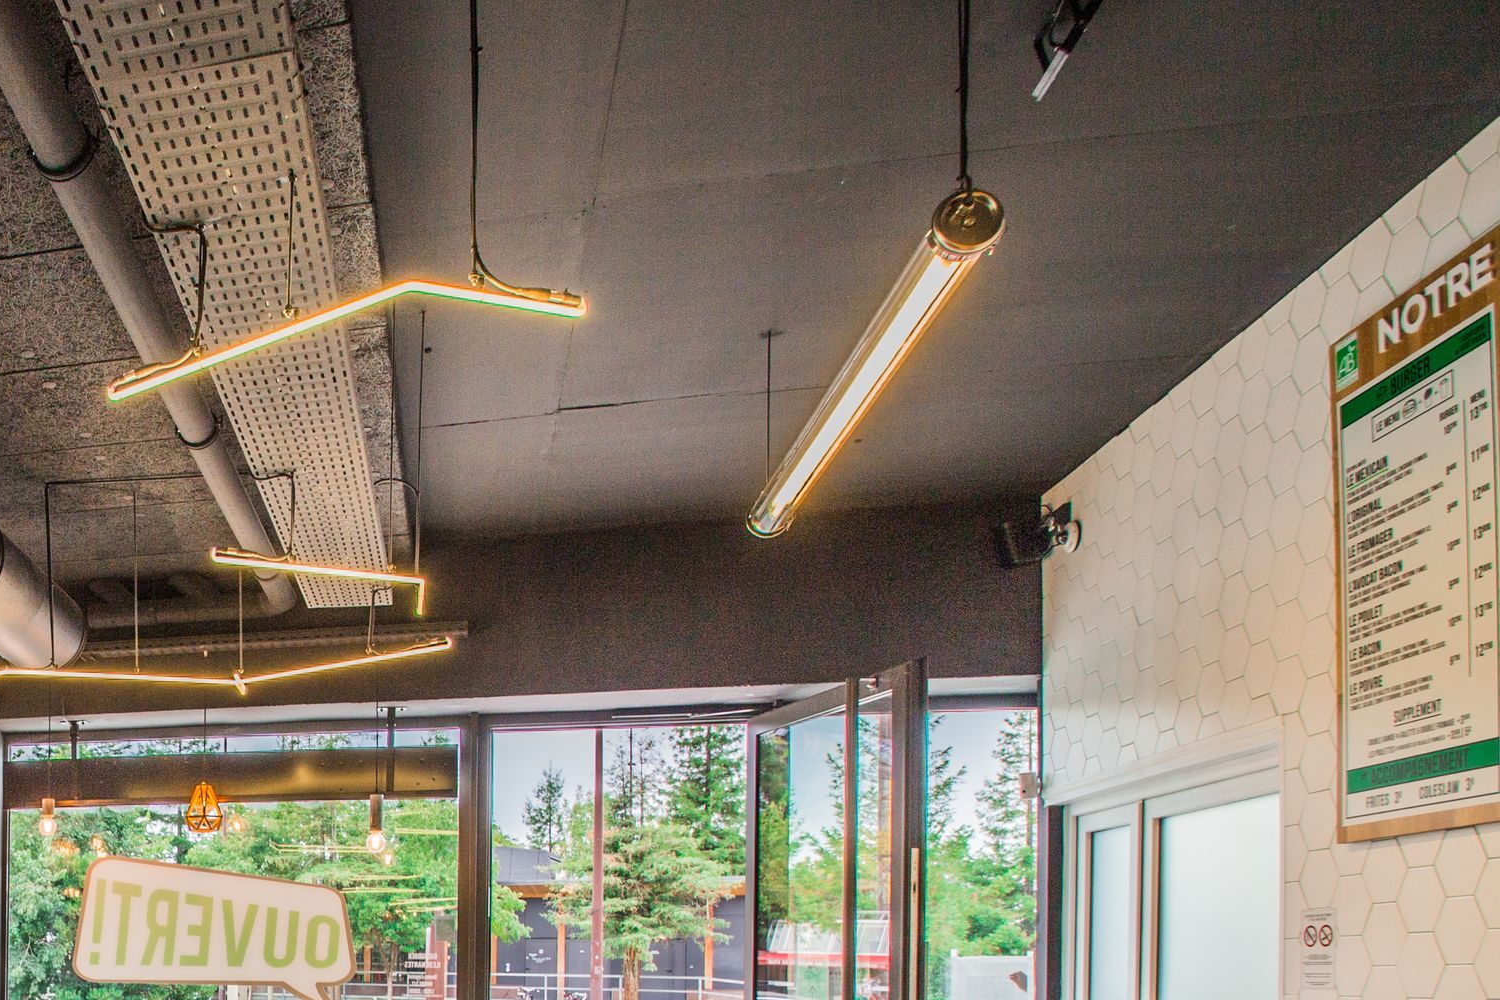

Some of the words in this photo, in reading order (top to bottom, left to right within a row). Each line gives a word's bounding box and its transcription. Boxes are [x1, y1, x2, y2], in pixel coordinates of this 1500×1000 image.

[1377, 242, 1494, 353] NOTRE
[1390, 354, 1430, 396] BURGER
[1346, 473, 1354, 488] LE
[1355, 454, 1387, 483] MEXICAIN
[1347, 544, 1355, 559] LE
[1356, 526, 1392, 555] FROMAGER
[1378, 558, 1402, 581] BACON
[1348, 613, 1356, 628] LE
[1357, 603, 1382, 624] POULET
[1349, 648, 1357, 662] LE
[1358, 639, 1381, 659] BACON
[1349, 682, 1357, 696] LE
[1359, 674, 1382, 693] POIVRE
[1393, 695, 1441, 723] SUPPLÉMENT
[1370, 747, 1469, 786] ACCOMPAGNEMENT
[1365, 793, 1389, 808] FRITES
[1419, 779, 1459, 799] COLESLAW
